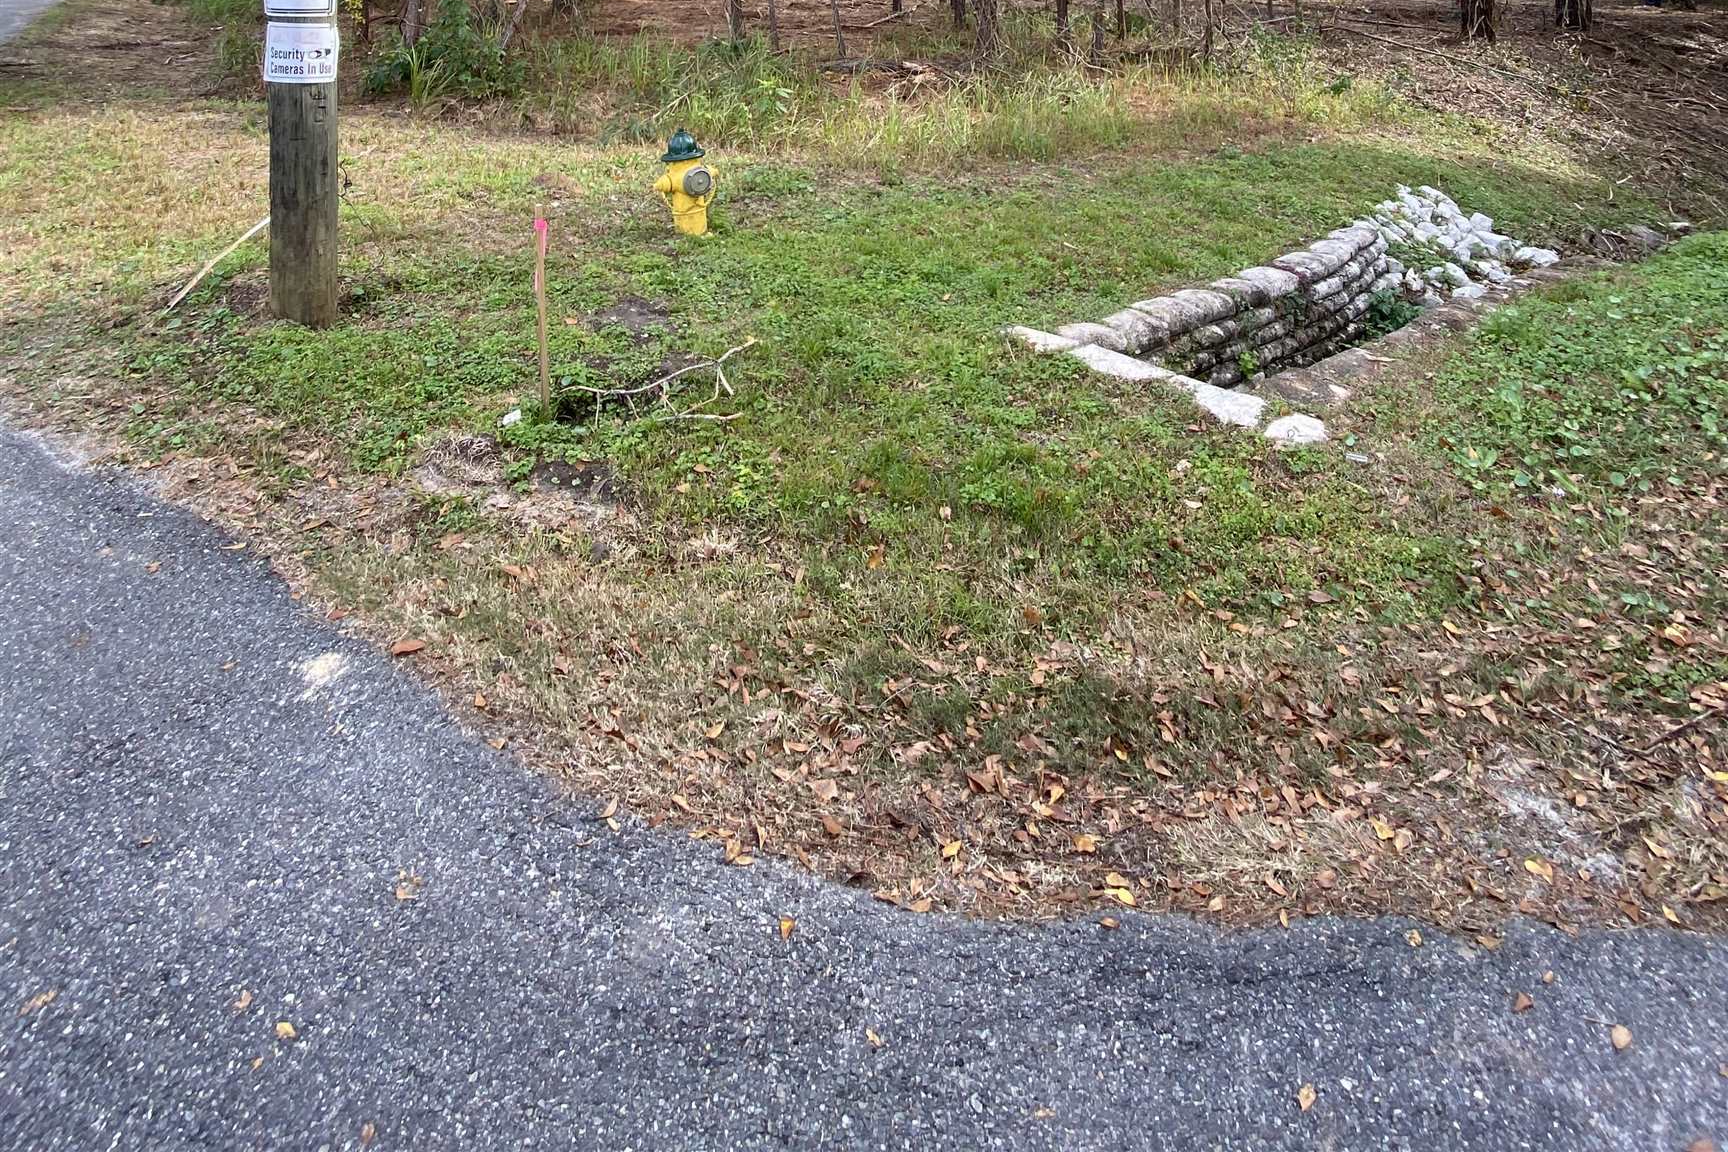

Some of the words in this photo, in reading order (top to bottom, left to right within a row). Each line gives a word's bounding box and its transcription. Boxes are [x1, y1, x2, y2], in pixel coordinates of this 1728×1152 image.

[270, 47, 304, 62] Security
[270, 62, 304, 75] Cameras
[307, 63, 316, 75] In
[319, 63, 332, 74] Use
